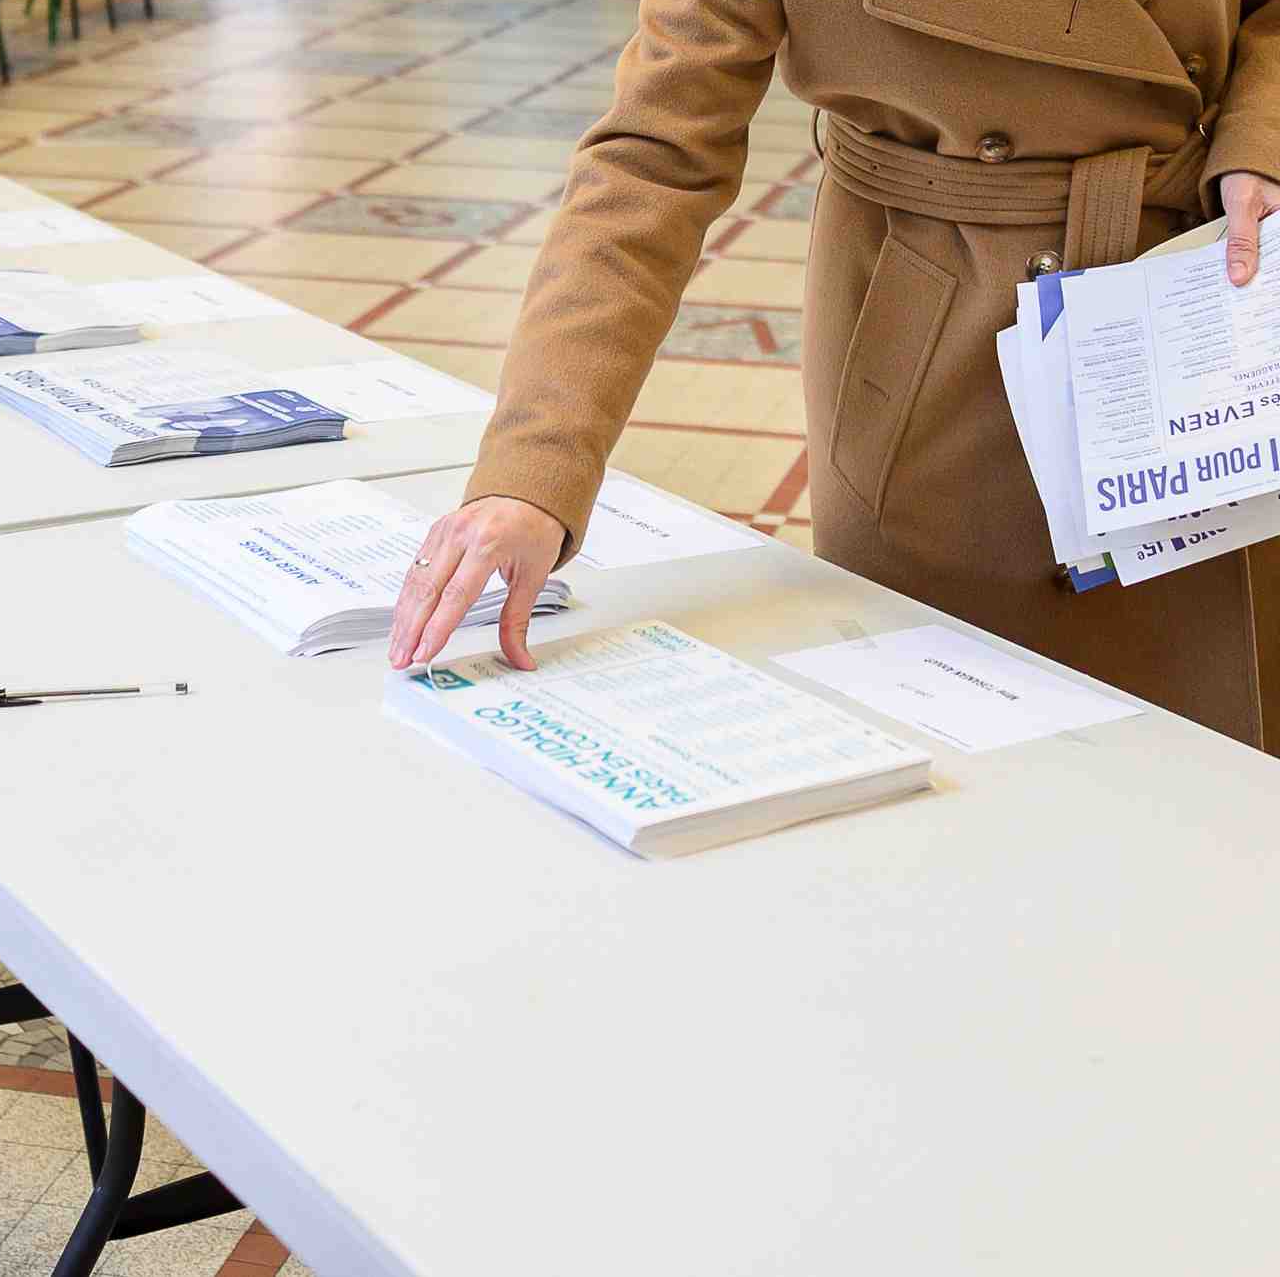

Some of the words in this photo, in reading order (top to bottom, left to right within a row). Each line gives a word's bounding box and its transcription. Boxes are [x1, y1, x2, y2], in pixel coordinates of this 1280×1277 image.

[1169, 401, 1255, 436] EVREN
[1198, 442, 1261, 483] POUR
[1097, 464, 1189, 512] PARIS
[239, 541, 281, 562] PARIS
[474, 707, 592, 767] HIDALGO
[504, 701, 601, 750] COMMUN
[592, 751, 634, 768] EN
[577, 767, 663, 808] ANNE
[625, 769, 696, 803] PARIS
